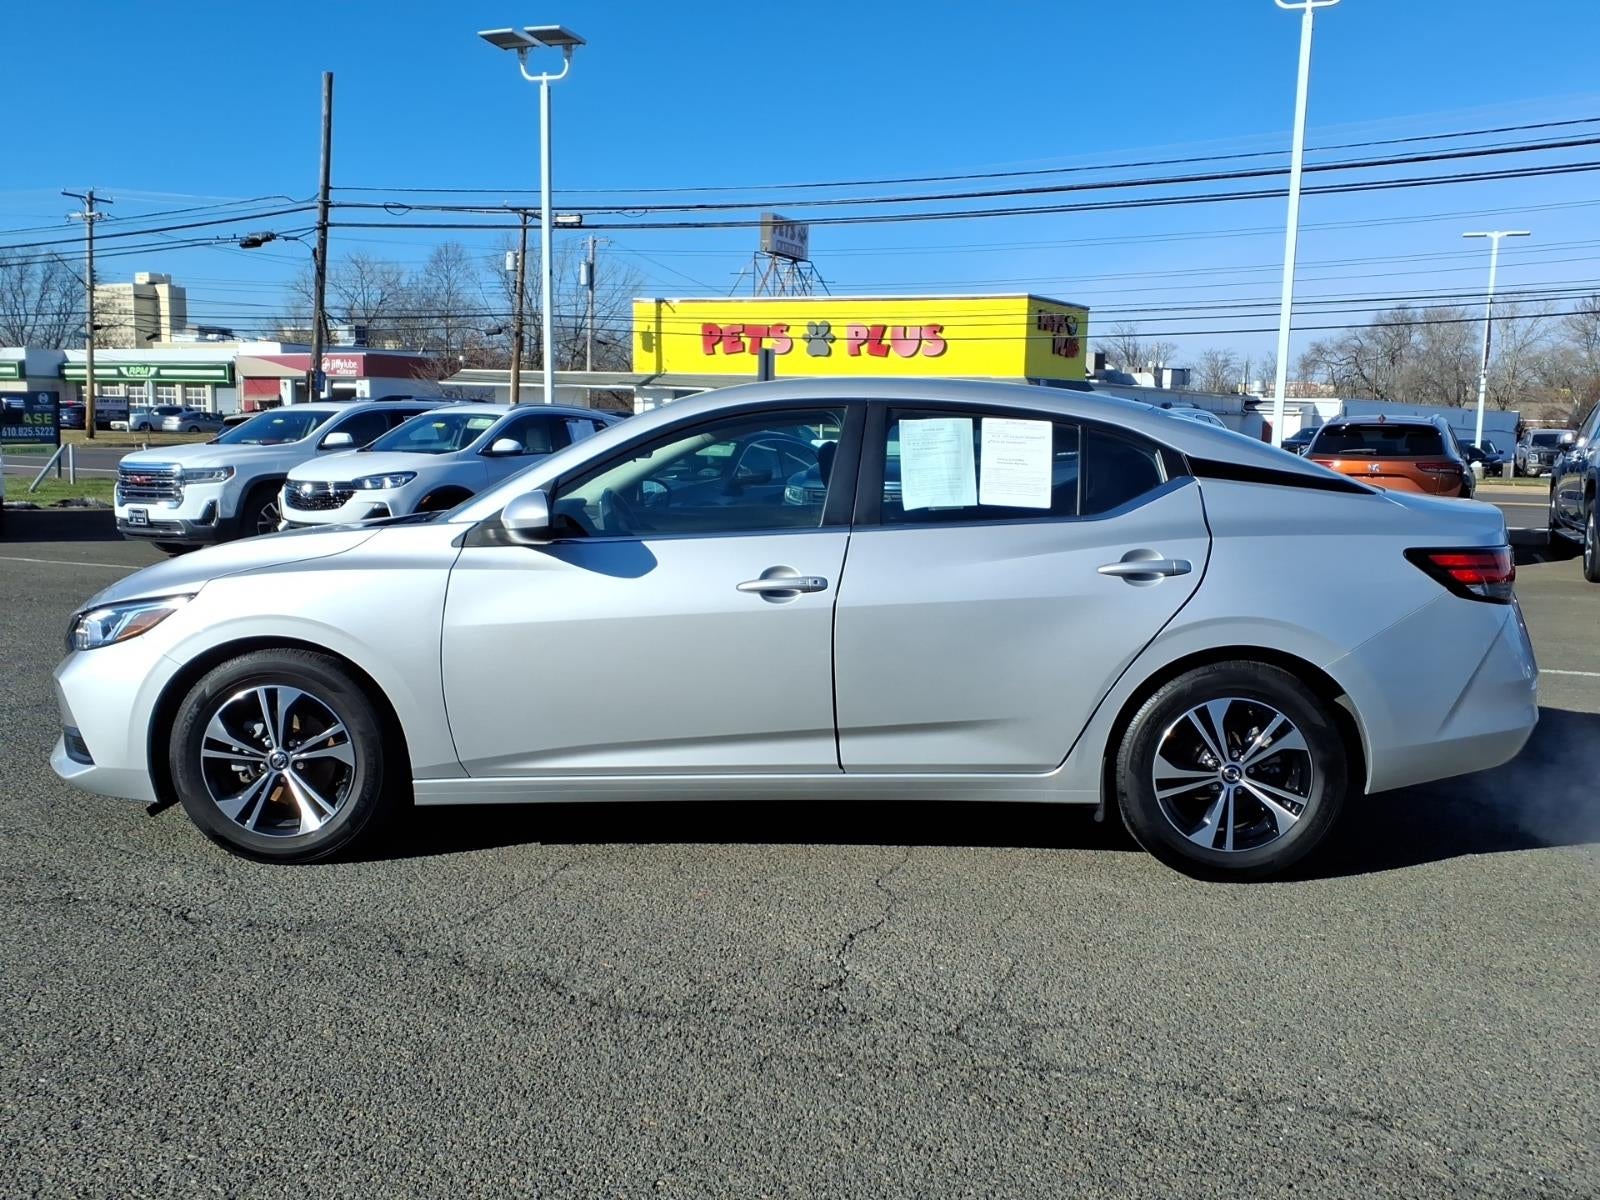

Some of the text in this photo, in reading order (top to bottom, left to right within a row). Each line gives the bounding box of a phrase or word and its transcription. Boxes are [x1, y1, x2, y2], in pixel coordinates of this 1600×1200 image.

[700, 322, 948, 358] PETS PLUS
[127, 366, 149, 376] RPM
